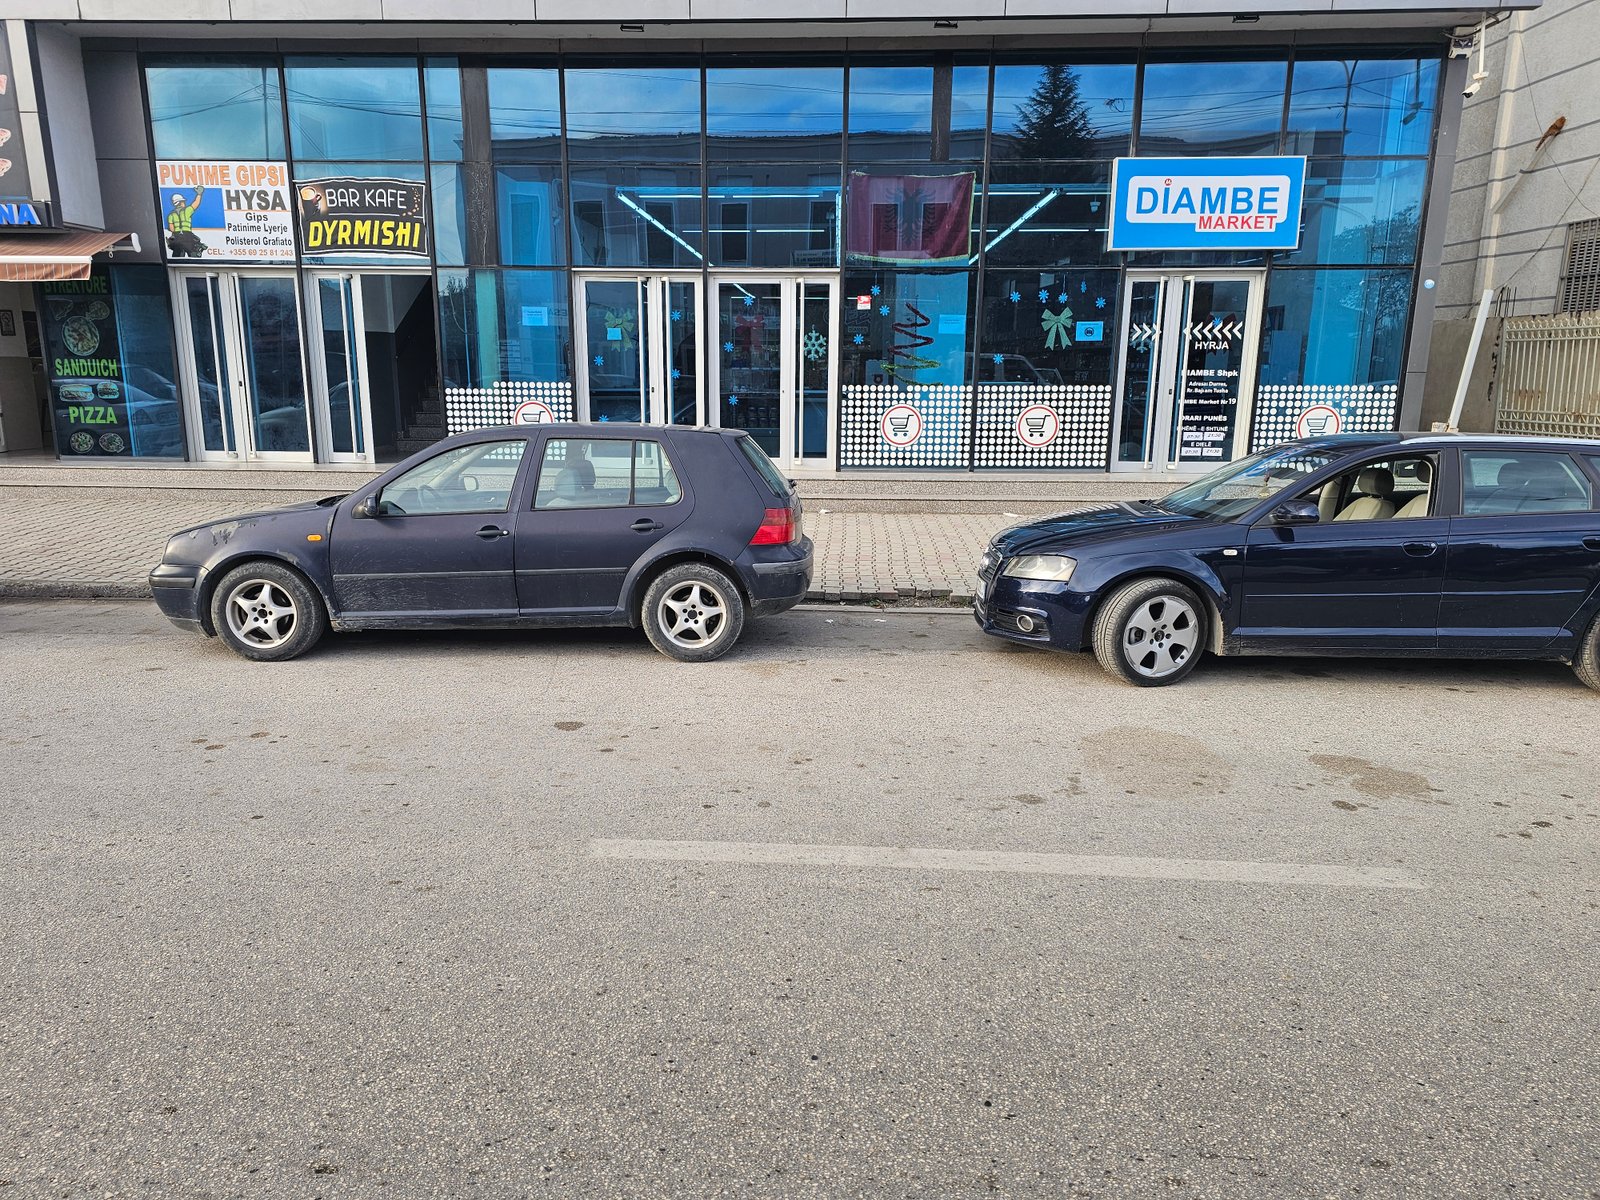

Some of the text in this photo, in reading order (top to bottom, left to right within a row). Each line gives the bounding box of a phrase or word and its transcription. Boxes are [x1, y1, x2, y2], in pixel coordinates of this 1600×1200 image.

[236, 165, 285, 186] GIPSI
[225, 189, 287, 210] HYSA
[325, 188, 407, 209] BAR KAFE
[245, 212, 268, 223] Gips
[1198, 216, 1278, 230] MARKET
[228, 223, 288, 234] Patinime Lyerje
[308, 220, 420, 248] DYRMISHI
[226, 236, 292, 246] Polisterol Grafiato
[1194, 340, 1229, 350] HYRJA
[54, 358, 118, 376] SANDUICH
[1217, 369, 1238, 378] Shpk
[68, 406, 118, 424] PIZZA
